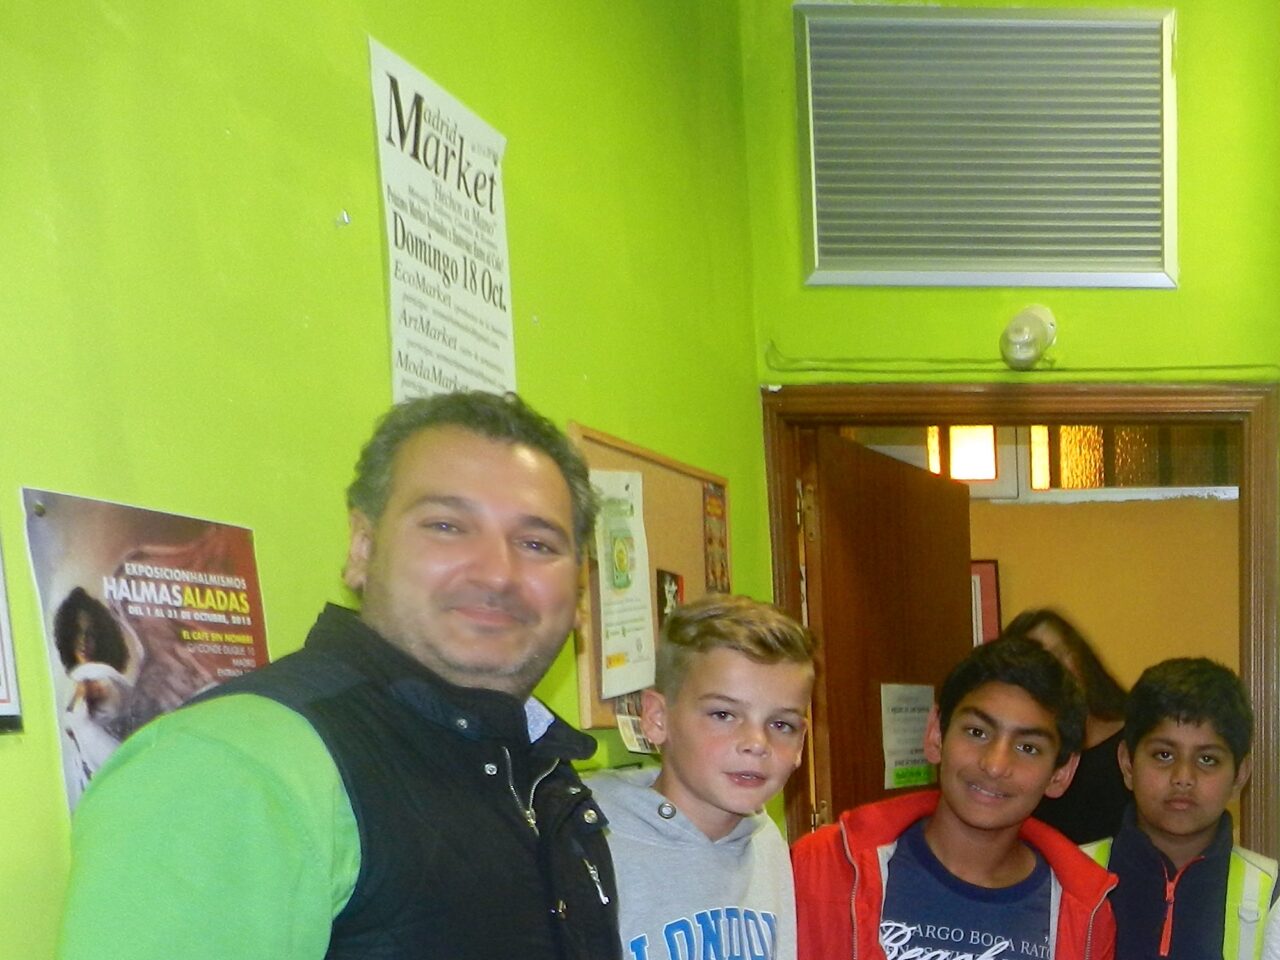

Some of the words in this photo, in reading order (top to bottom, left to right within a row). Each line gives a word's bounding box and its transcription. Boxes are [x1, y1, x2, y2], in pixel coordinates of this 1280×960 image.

[393, 211, 458, 288] Domingo
[463, 254, 478, 295] 18
[481, 268, 507, 313] Oct.
